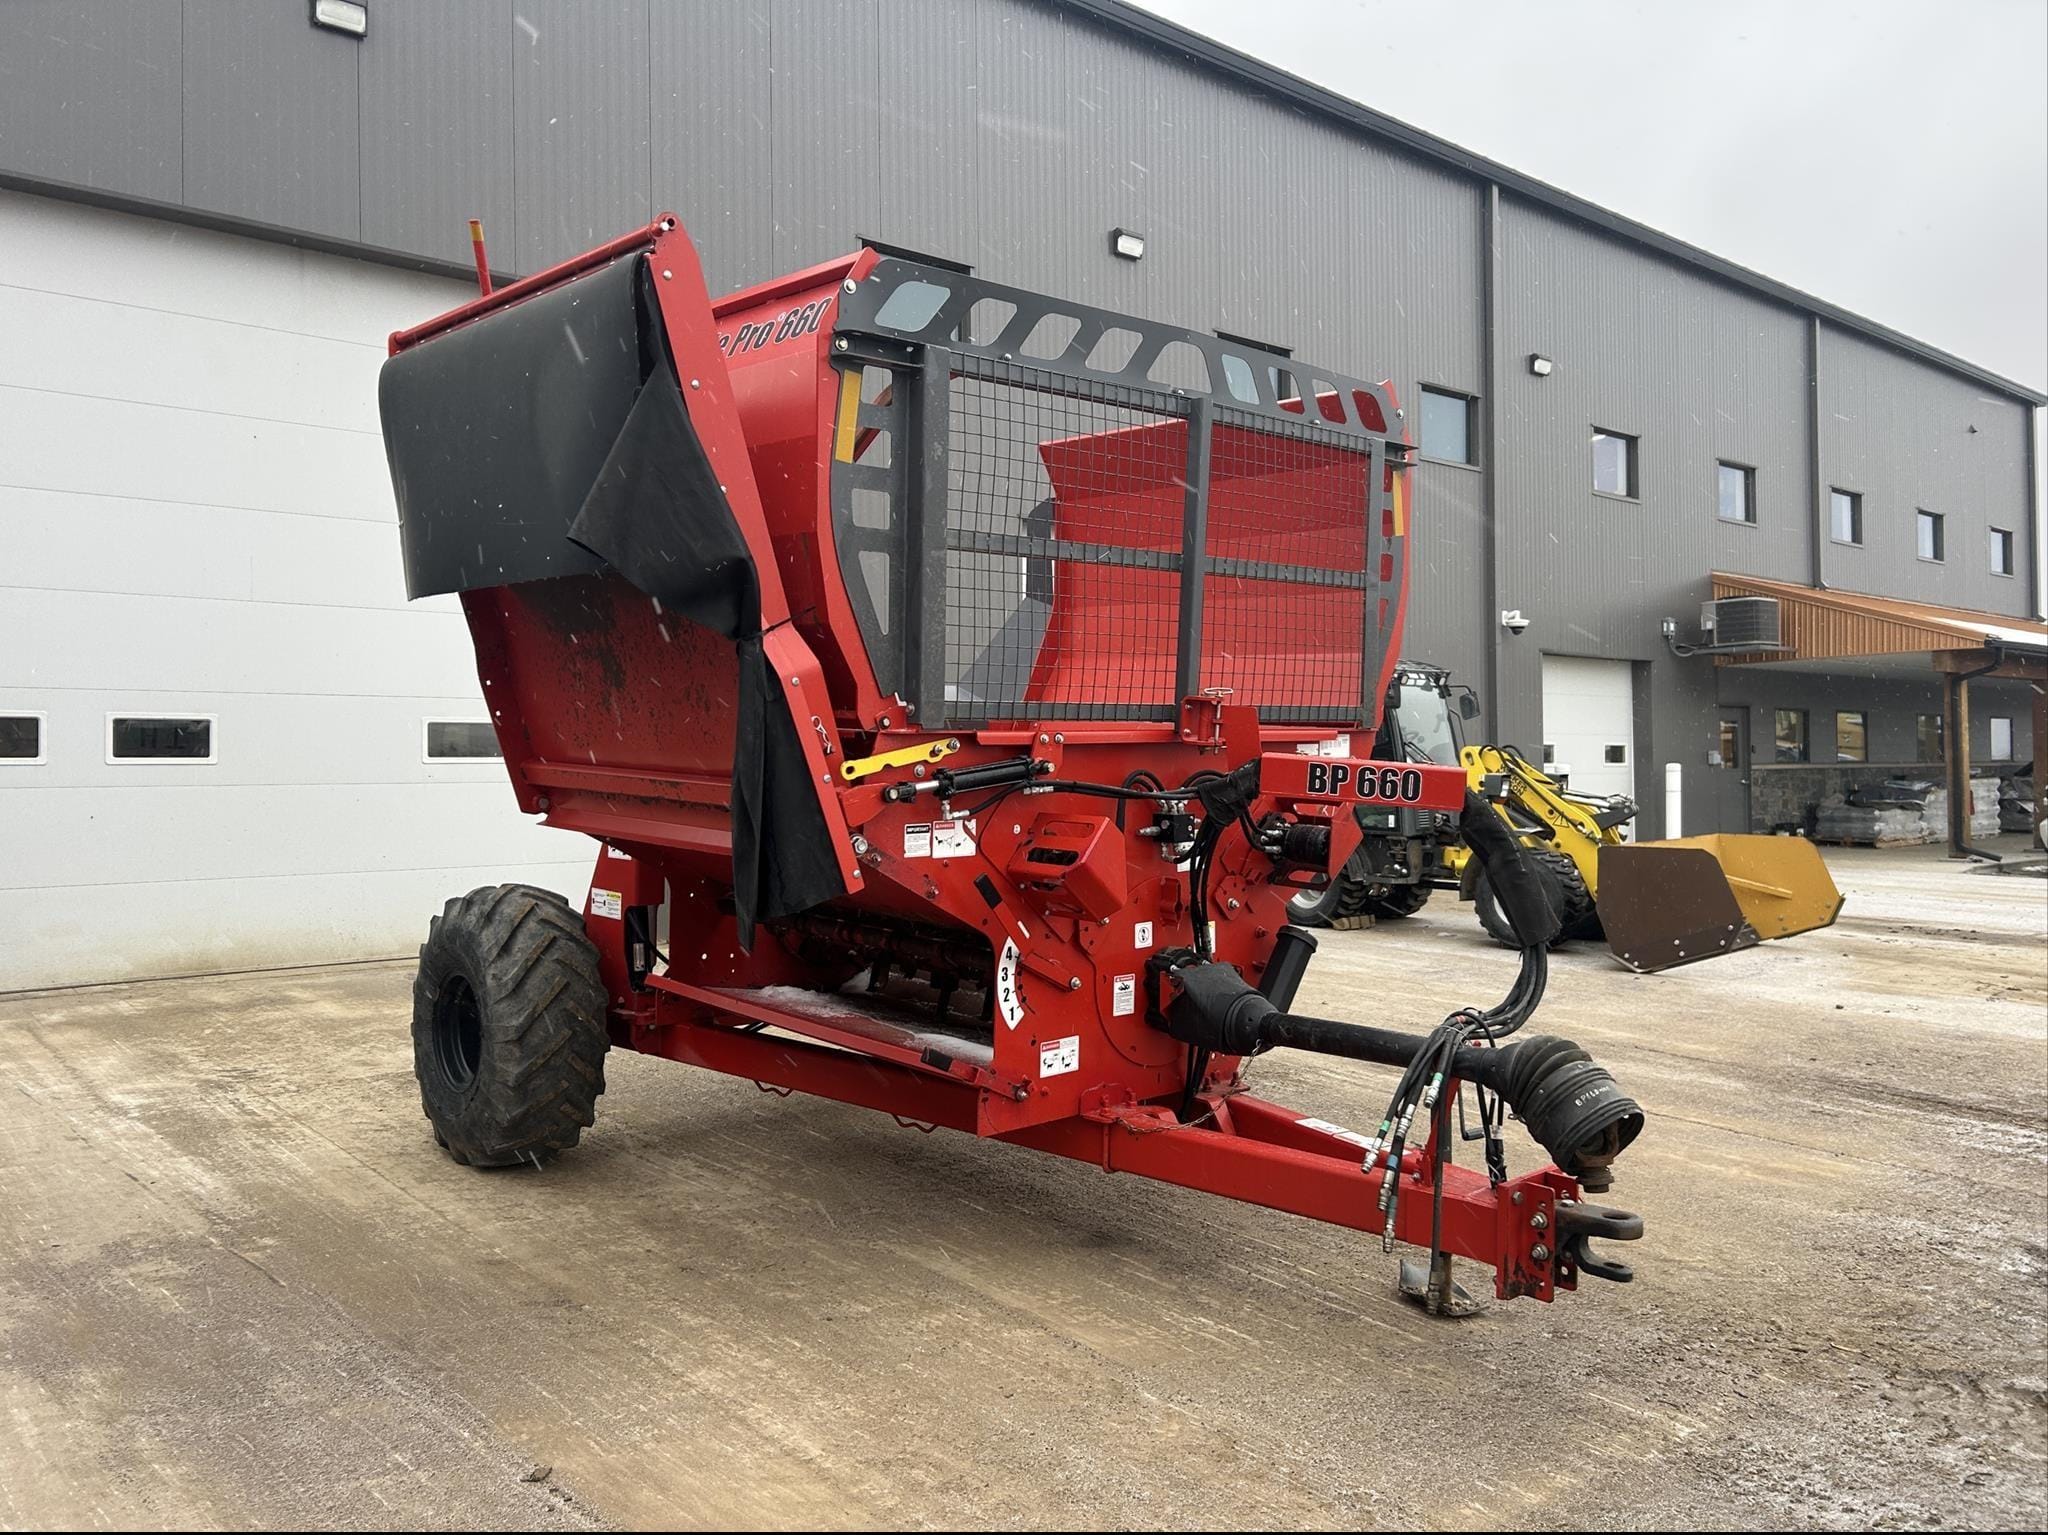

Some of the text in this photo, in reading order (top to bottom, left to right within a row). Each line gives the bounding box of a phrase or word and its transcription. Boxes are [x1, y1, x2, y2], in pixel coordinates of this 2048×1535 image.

[727, 296, 833, 358] Pro 660
[1306, 761, 1422, 803] BP 660
[1005, 946, 1013, 961] 4
[1001, 967, 1009, 982] 3
[1003, 987, 1010, 1003] 2
[1009, 1006, 1015, 1021] 1
